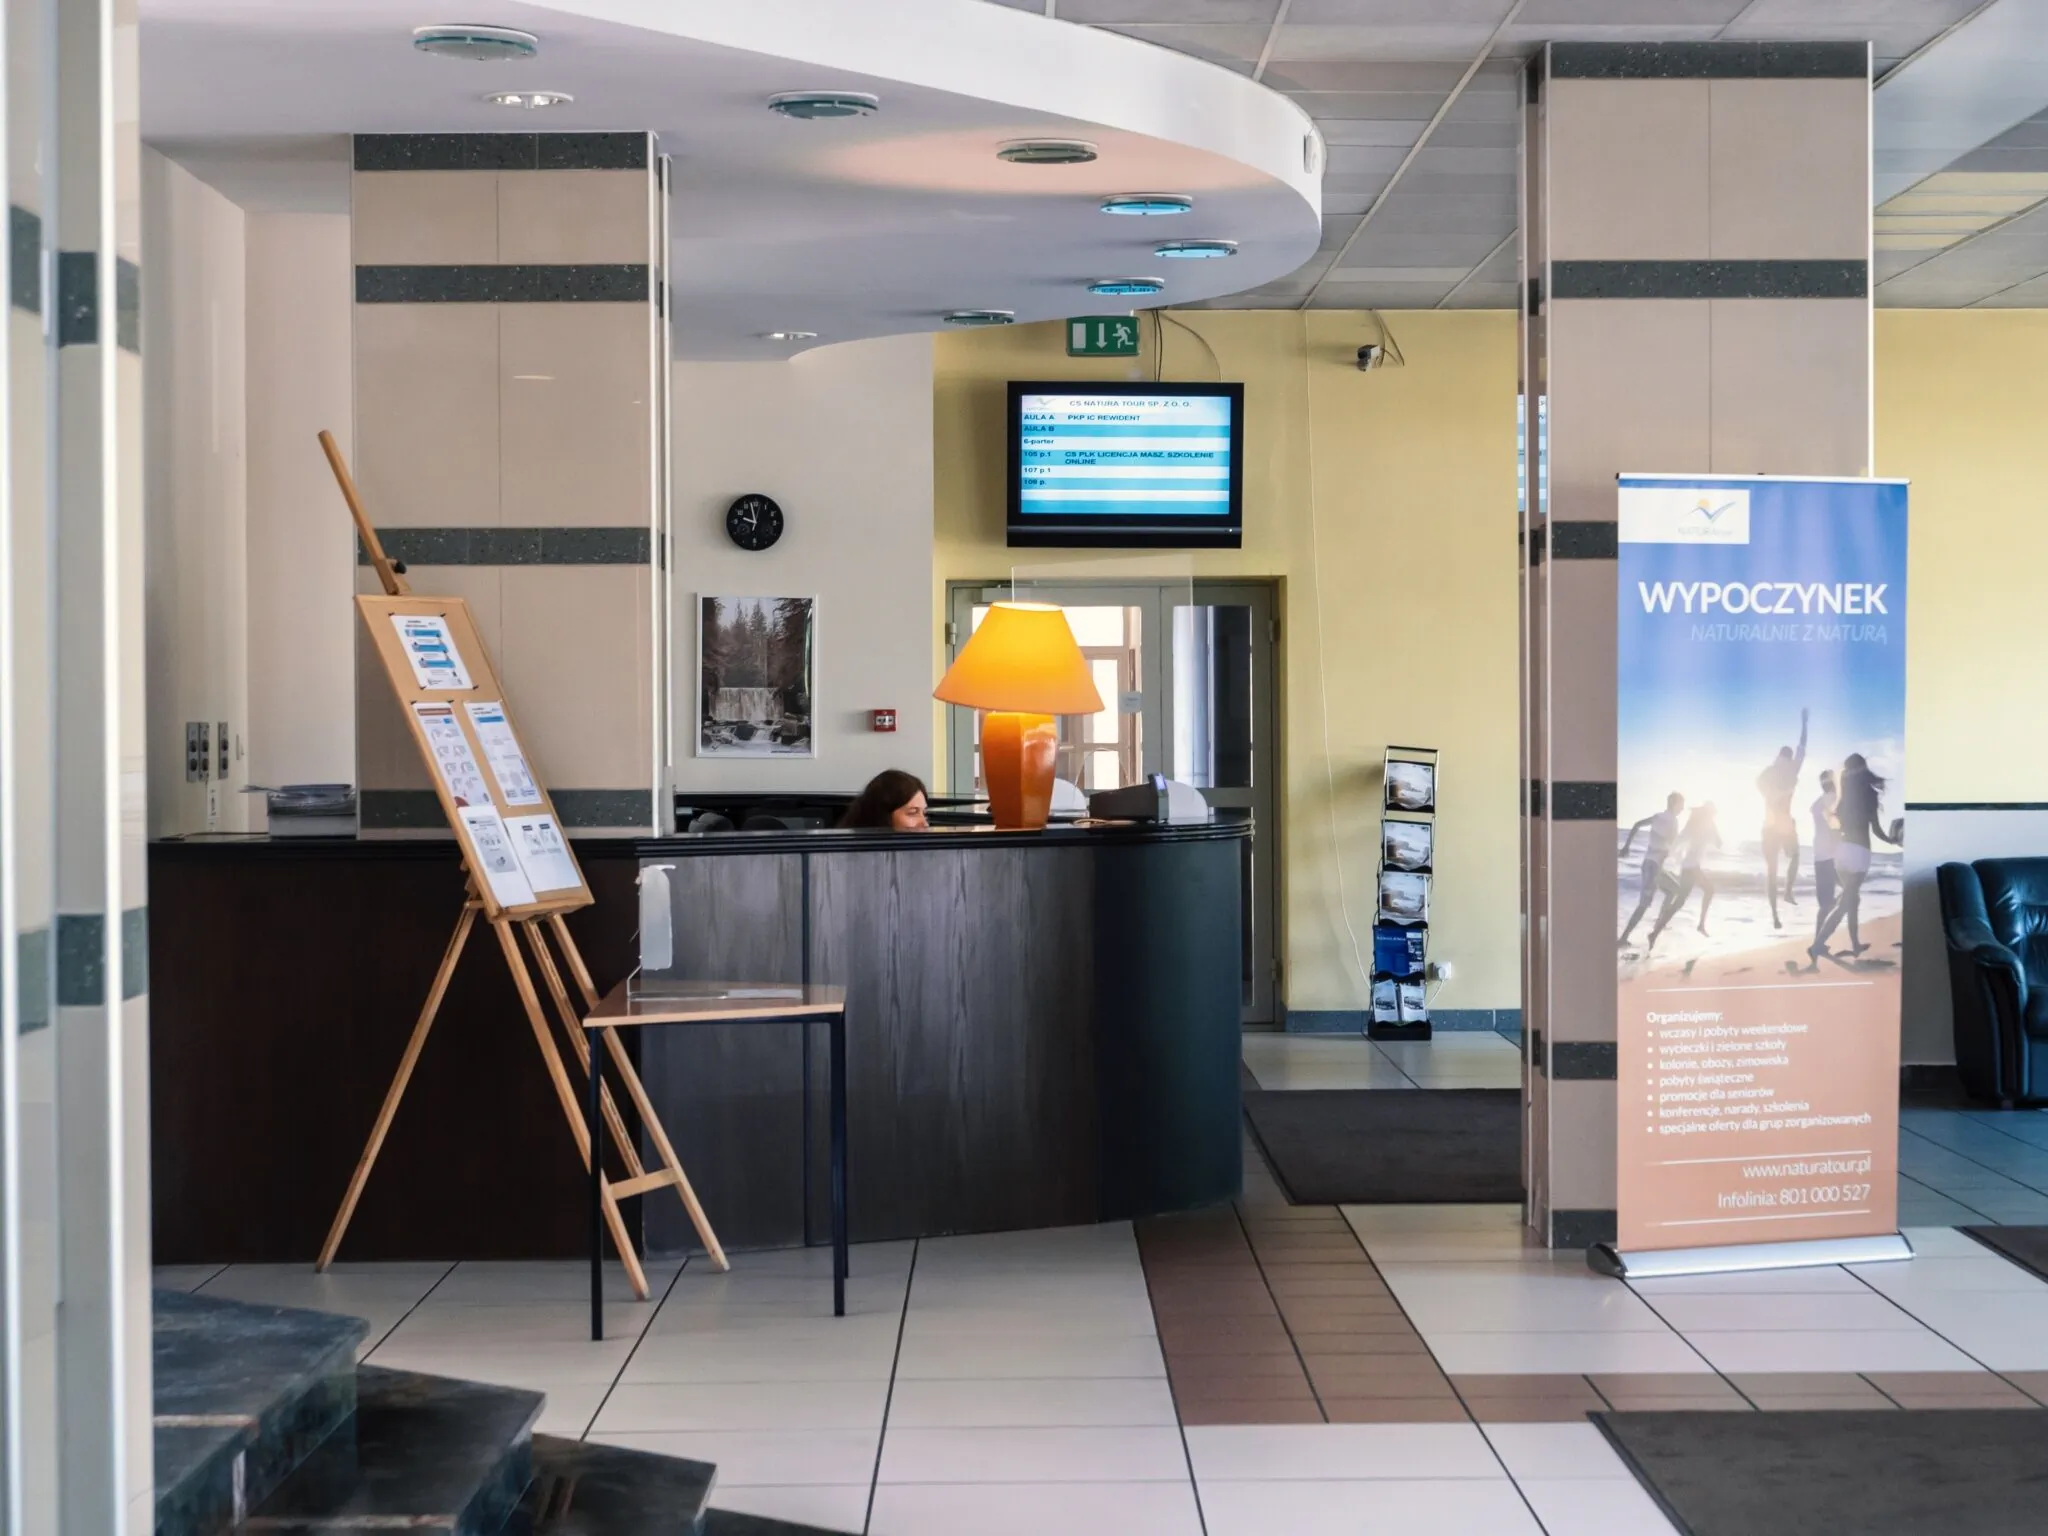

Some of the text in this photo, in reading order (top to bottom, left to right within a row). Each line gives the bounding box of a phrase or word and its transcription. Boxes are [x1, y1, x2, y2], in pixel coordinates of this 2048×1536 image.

[1638, 582, 1888, 614] WYPOCZYNEK
[1691, 623, 1888, 645] NATURALNIE Z NATURĄ
[1647, 1010, 1723, 1024] Organizujemy:
[1659, 1028, 1697, 1039] wczasy
[1703, 1025, 1739, 1038] pobyty
[1741, 1023, 1808, 1035] weekendowe
[1659, 1041, 1709, 1056] wycieczki
[1716, 1041, 1752, 1052] zielone
[1755, 1039, 1786, 1051] szkoły
[1660, 1055, 1789, 1070] kolonie, obozy, zimowiska
[1660, 1072, 1754, 1088] pobyty świąteczne
[1660, 1087, 1774, 1104] promocje dla seniorów
[1660, 1104, 1722, 1117] konferencje,
[1763, 1100, 1809, 1112] szkolenia
[1659, 1112, 1871, 1135] specjalne oferty dla grup zorganizowanych
[1742, 1156, 1872, 1177] www.naturatour.pl
[1718, 1184, 1871, 1208] Infolinia: 801 000 527
